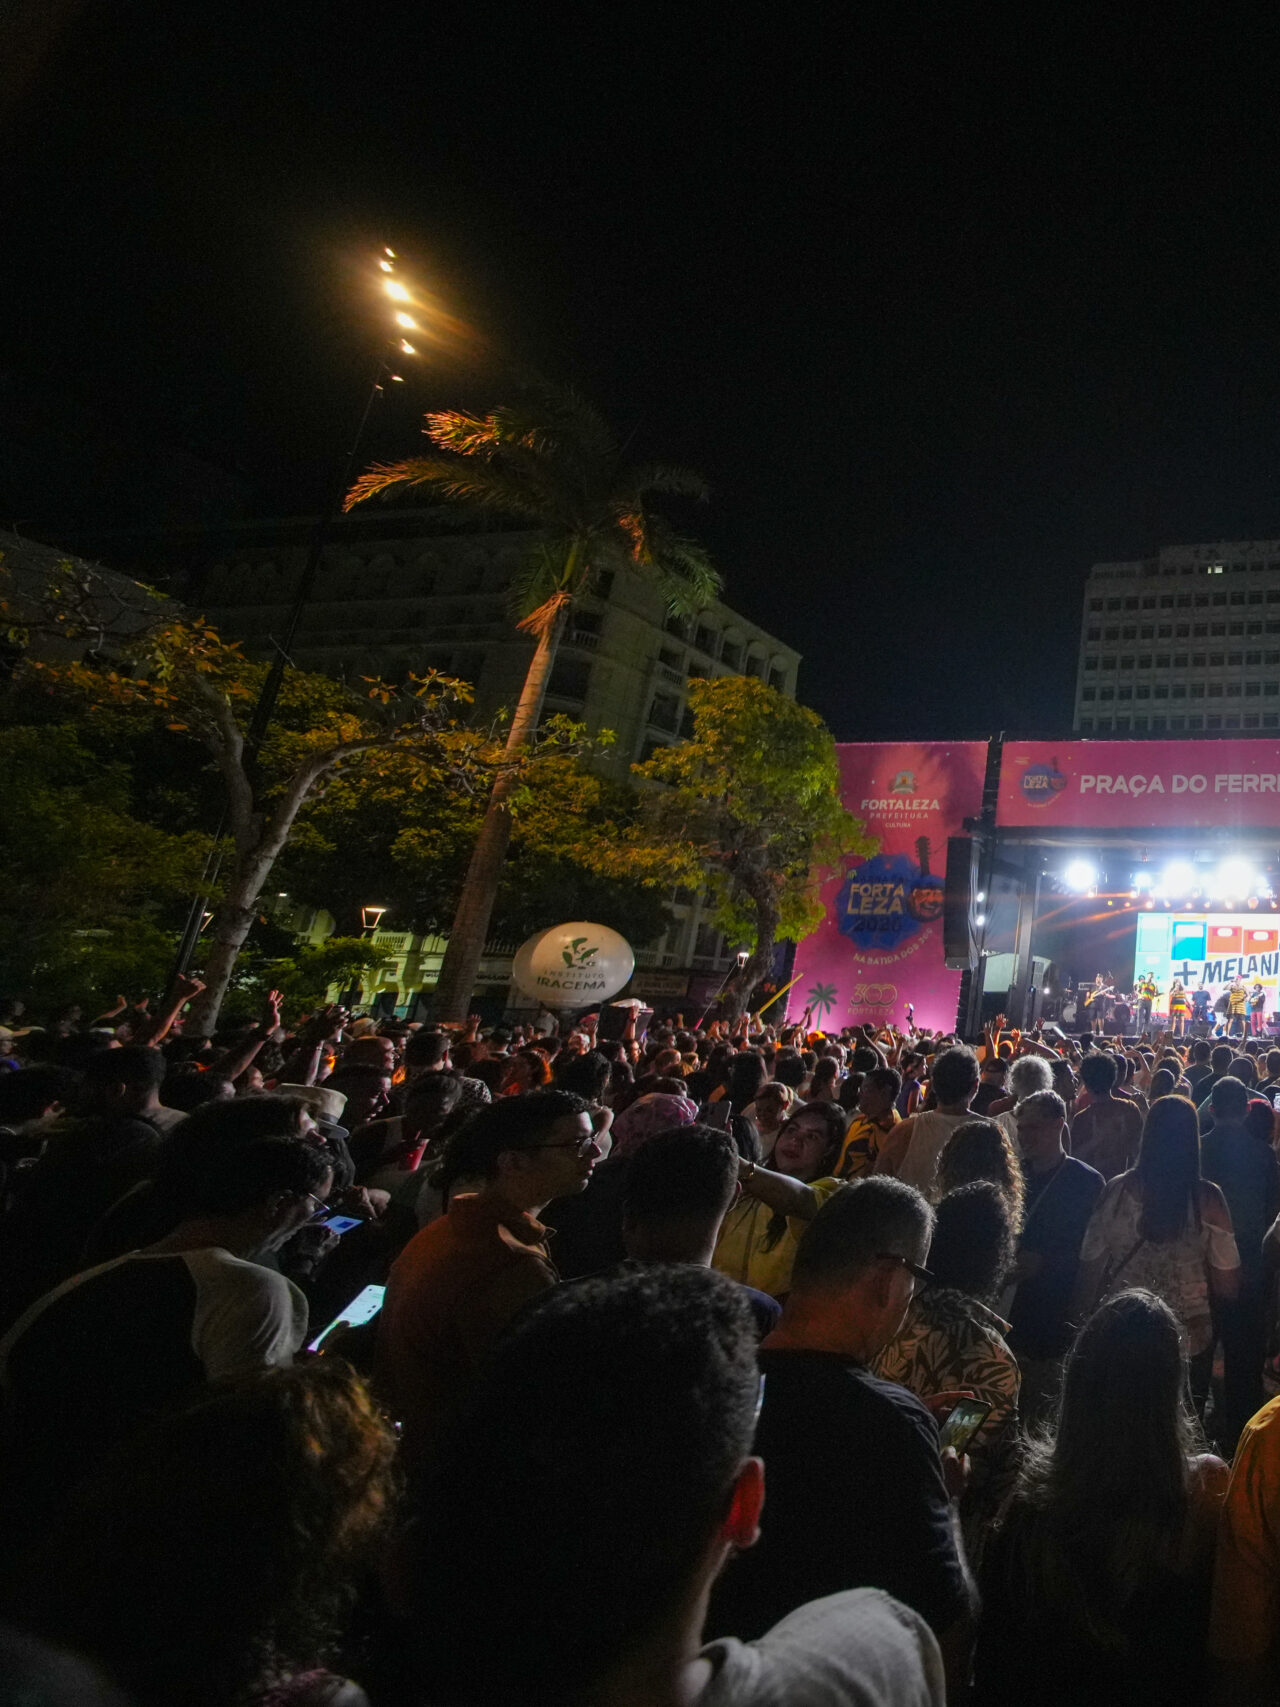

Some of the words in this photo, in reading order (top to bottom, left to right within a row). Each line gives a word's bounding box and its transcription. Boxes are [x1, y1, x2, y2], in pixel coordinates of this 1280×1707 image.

[1080, 774, 1165, 797] PRAÇA
[1172, 774, 1207, 793] DO
[861, 799, 940, 811] FORTALEZA
[851, 883, 905, 897] FORTA
[847, 896, 904, 915] LEZA
[544, 969, 605, 979] INSTITUTO
[536, 976, 606, 990] IRACEMA
[847, 1007, 895, 1015] FORTALEZA
